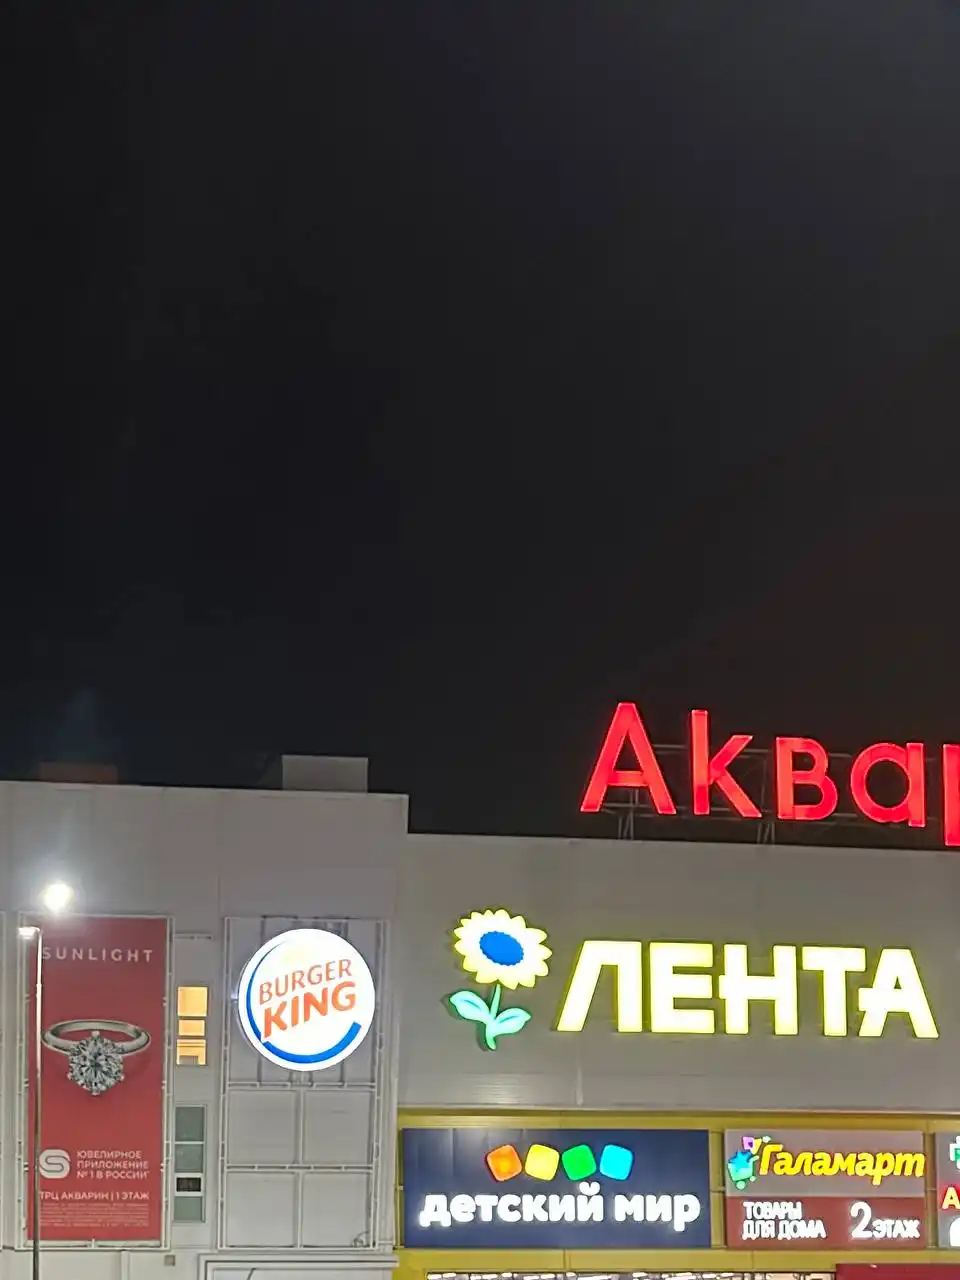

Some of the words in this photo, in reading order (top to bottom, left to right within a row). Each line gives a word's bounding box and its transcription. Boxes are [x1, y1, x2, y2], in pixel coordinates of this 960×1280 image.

[580, 702, 960, 846] Аква
[41, 946, 154, 963] SUNLIGHT
[259, 959, 352, 1005] BURGER
[556, 940, 939, 1039] ЛЕНТА
[264, 981, 356, 1038] KING
[76, 1150, 142, 1159] ЮВЕЛИРНОЕ
[76, 1160, 149, 1169] ПРИЛОЖЕНИЕ
[759, 1143, 926, 1186] Галамарт
[39, 1191, 59, 1201] ТРЦ
[61, 1191, 109, 1200] АКВАРИН
[121, 1191, 149, 1200] ЭТАЖ
[419, 1181, 604, 1228] детский
[614, 1192, 701, 1231] мир
[743, 1201, 802, 1220] ТОВАРЫ
[742, 1219, 775, 1240] ДЛЯ
[778, 1219, 828, 1240] ДОМА
[850, 1201, 873, 1239] 2
[871, 1219, 921, 1239] ЭТАЖ
